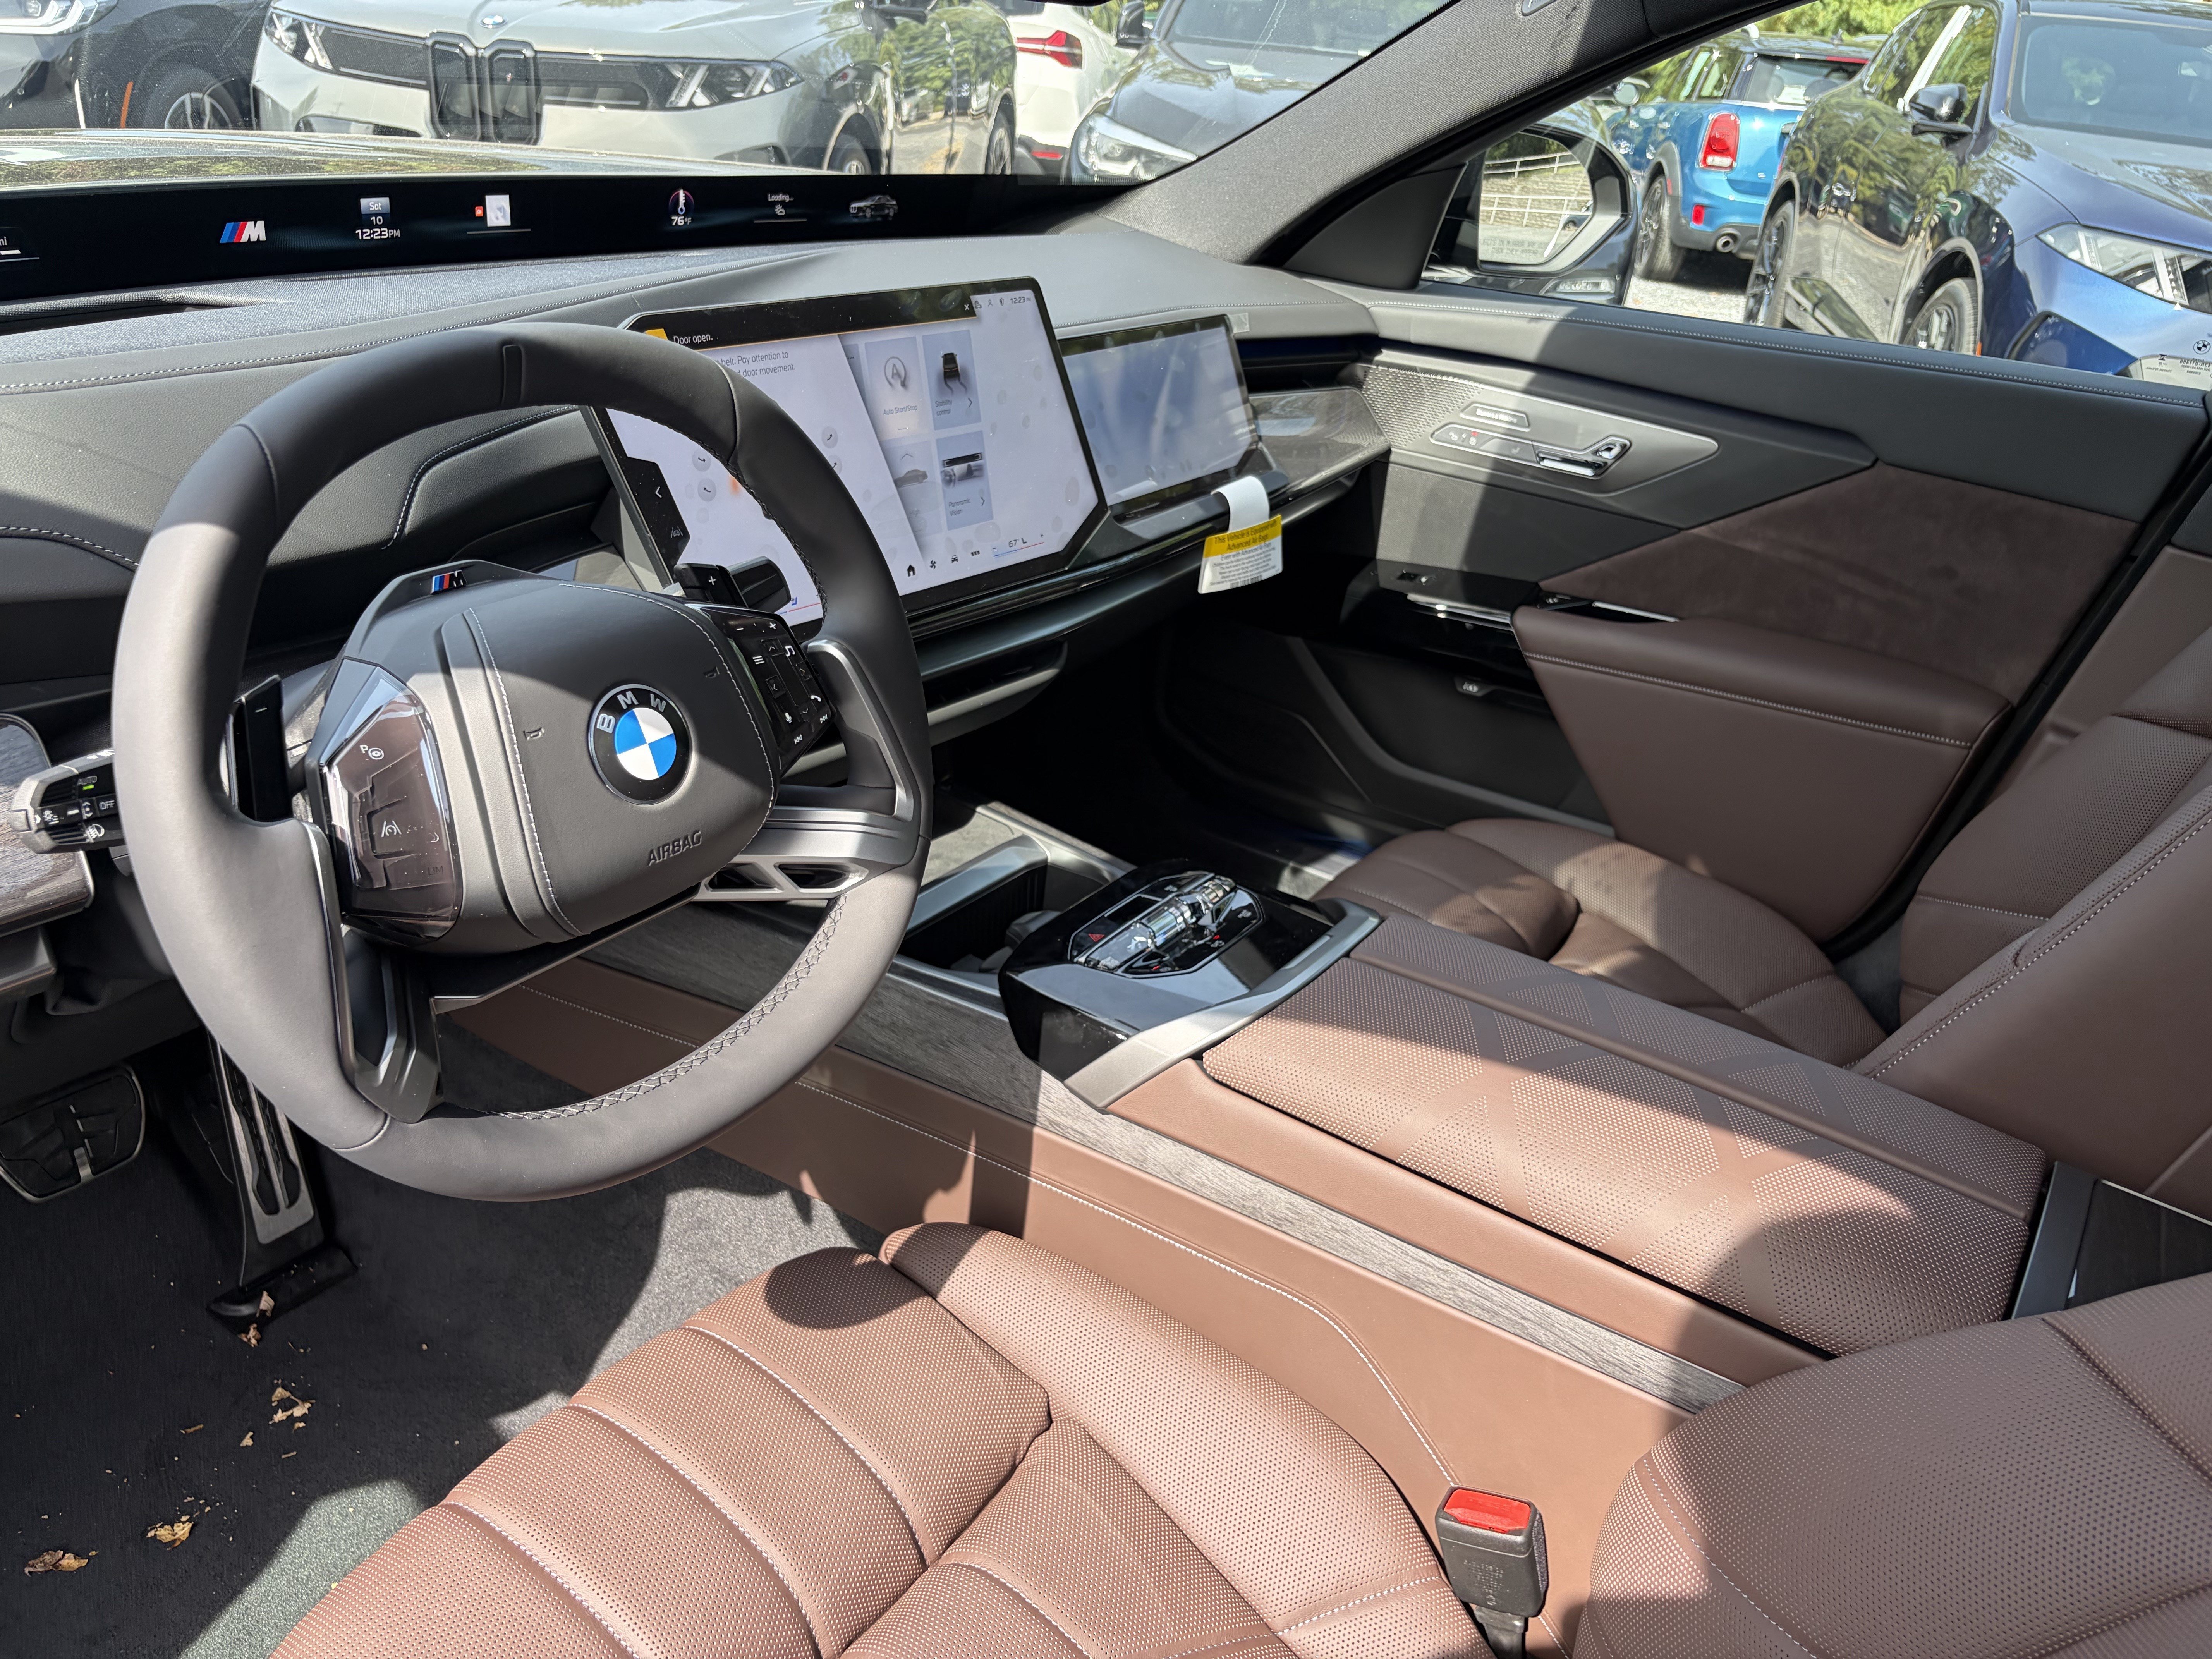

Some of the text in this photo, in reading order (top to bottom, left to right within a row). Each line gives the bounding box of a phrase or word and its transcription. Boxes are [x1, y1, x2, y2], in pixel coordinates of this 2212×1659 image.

[767, 193, 794, 202] Loading...
[369, 202, 382, 210] Sat
[371, 216, 383, 225] 10
[671, 216, 692, 226] 76°F
[673, 334, 713, 344] Door open.
[721, 357, 736, 366] belt.
[738, 356, 750, 365] Pay
[751, 352, 781, 363] attention
[743, 369, 757, 377] door
[760, 363, 796, 375] movement.
[597, 691, 666, 733] BMW
[77, 776, 97, 786] AUTO
[99, 800, 115, 810] OFF
[648, 830, 702, 867] AIRBAG
[428, 865, 443, 876] LIM
